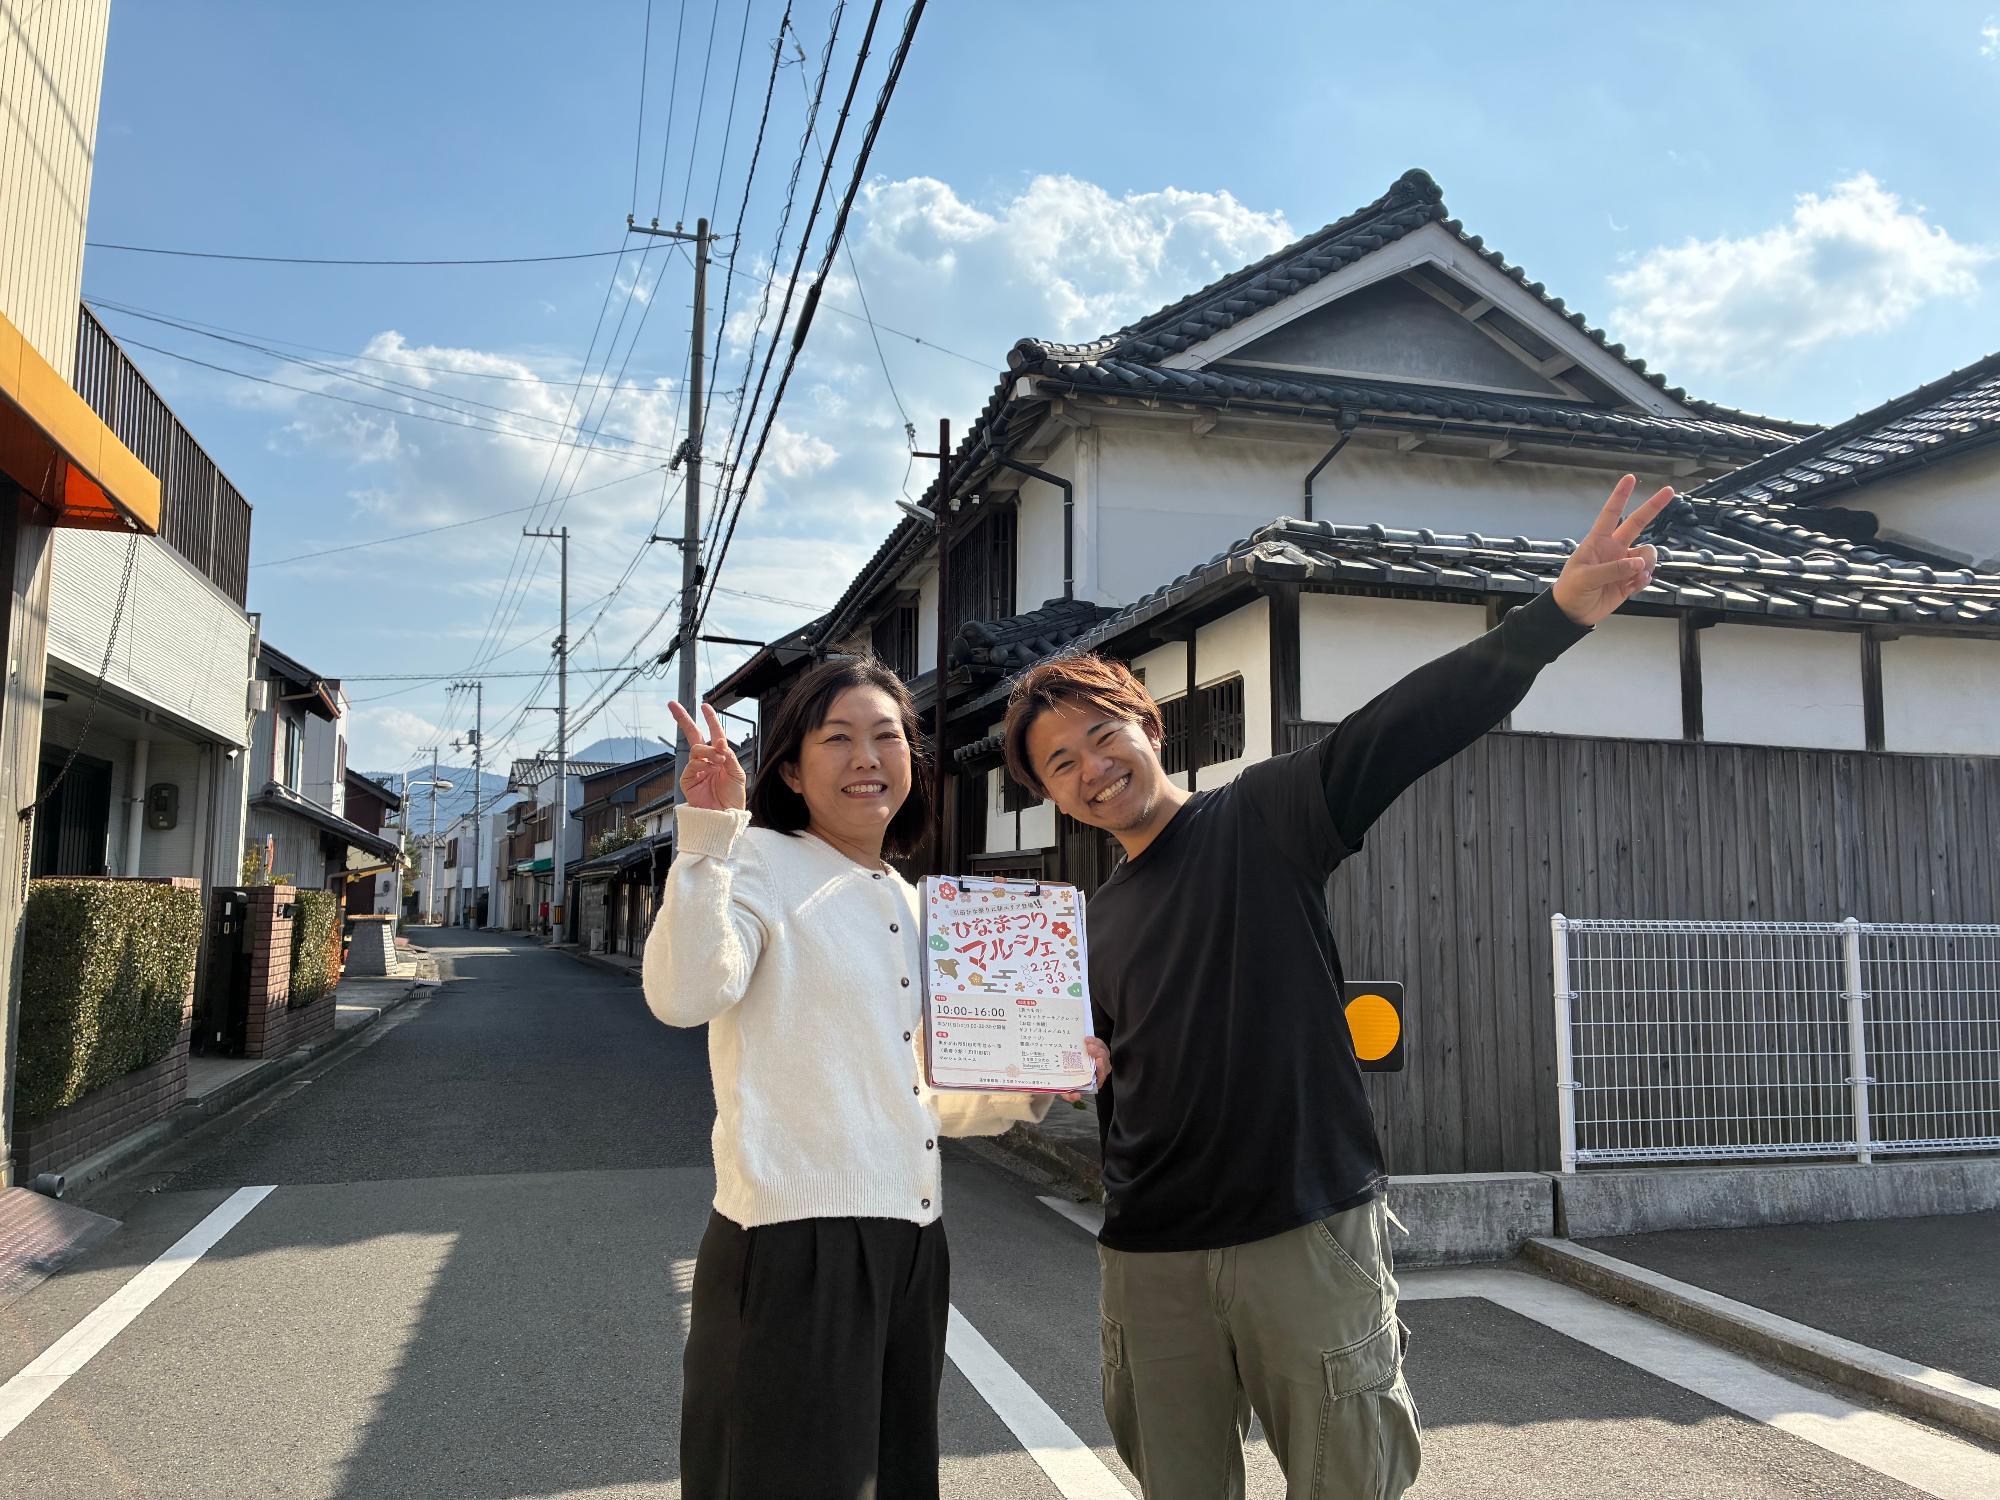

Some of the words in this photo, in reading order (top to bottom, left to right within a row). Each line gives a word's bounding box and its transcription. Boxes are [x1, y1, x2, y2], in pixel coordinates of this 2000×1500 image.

[952, 912, 1048, 939] ひなまつり
[954, 935, 1057, 972] マルシェ
[1030, 959, 1060, 973] 2.27
[936, 1004, 1006, 1018] 10:00-16:00
